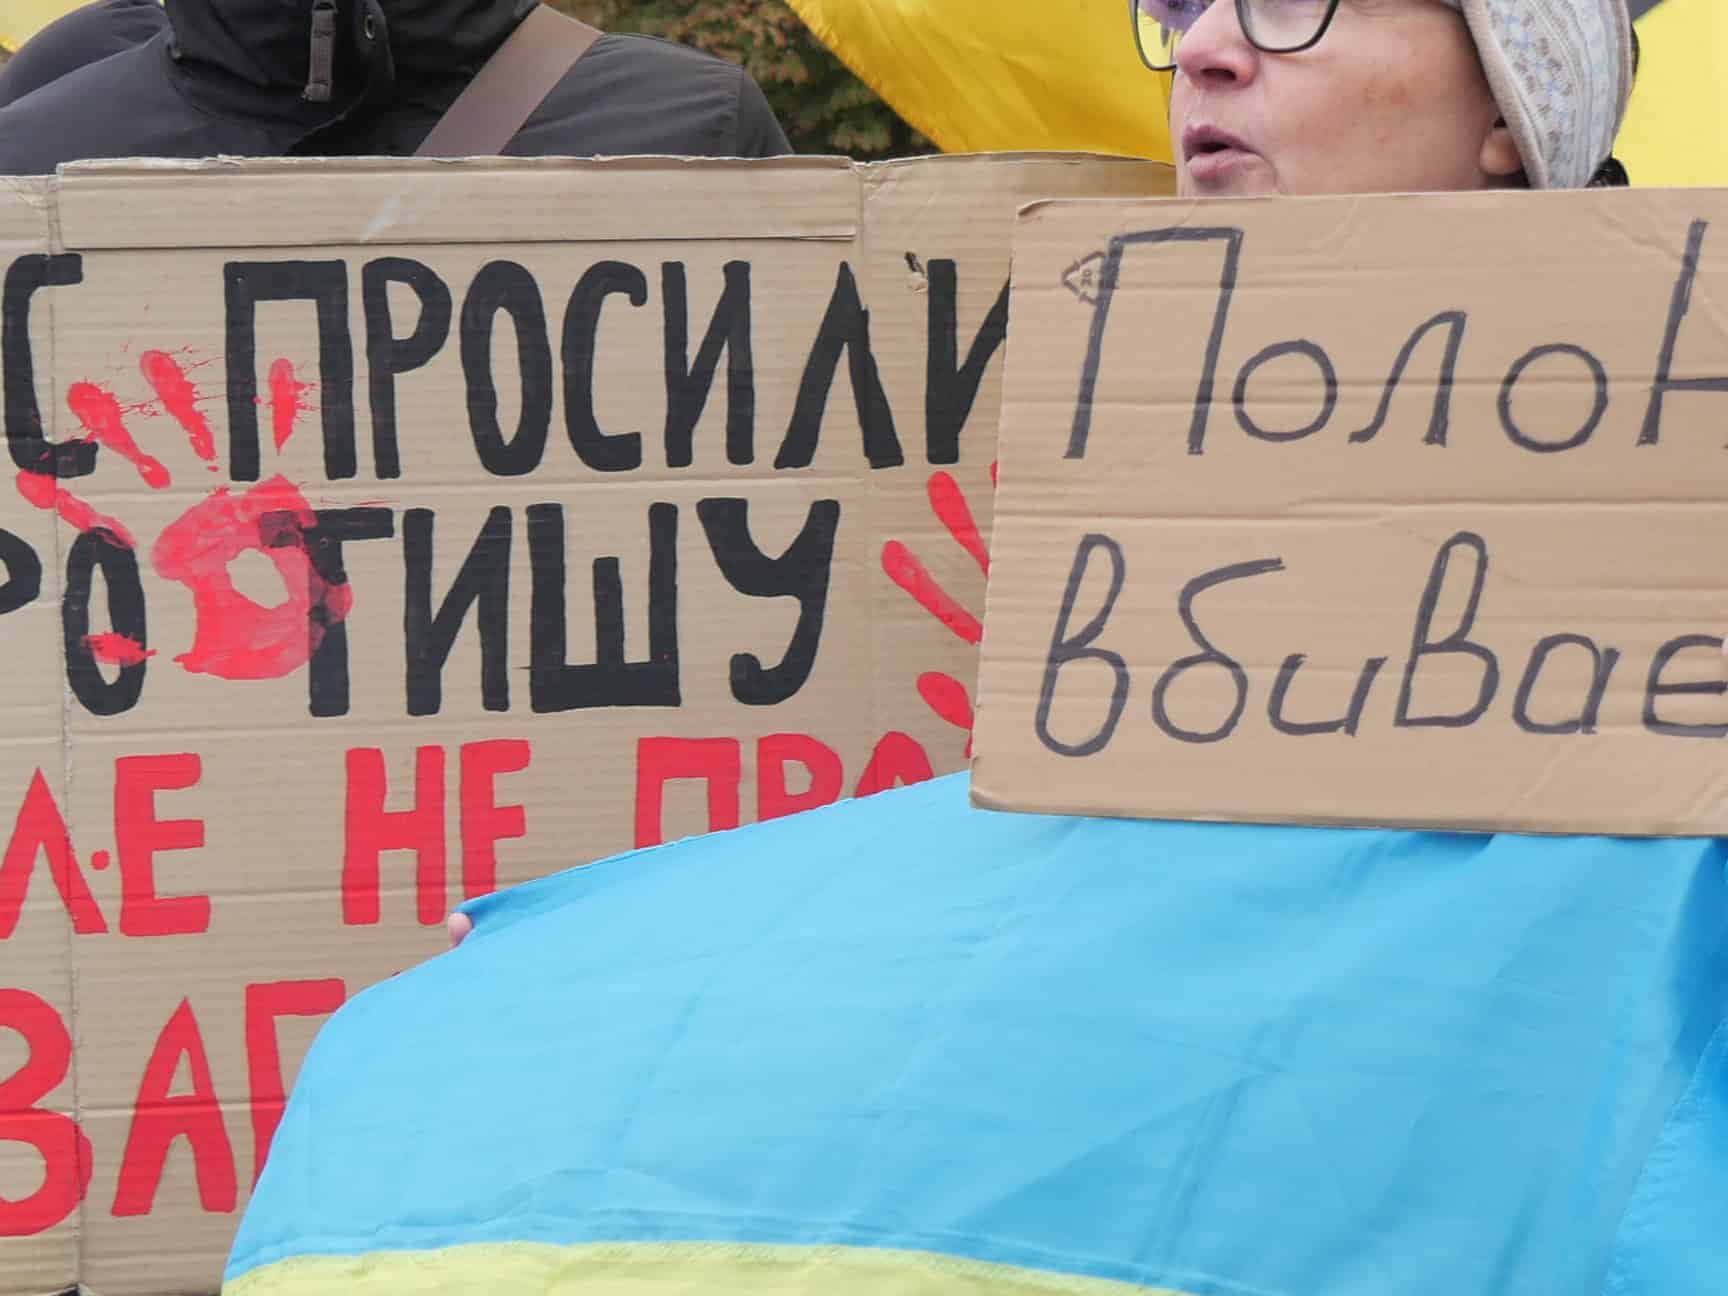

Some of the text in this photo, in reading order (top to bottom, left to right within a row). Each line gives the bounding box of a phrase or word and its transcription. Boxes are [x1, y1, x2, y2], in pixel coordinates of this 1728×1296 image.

[222, 255, 1010, 483] ПРОСИЛИ
[258, 498, 841, 719] ТИШУ
[342, 738, 531, 926] НЕ
